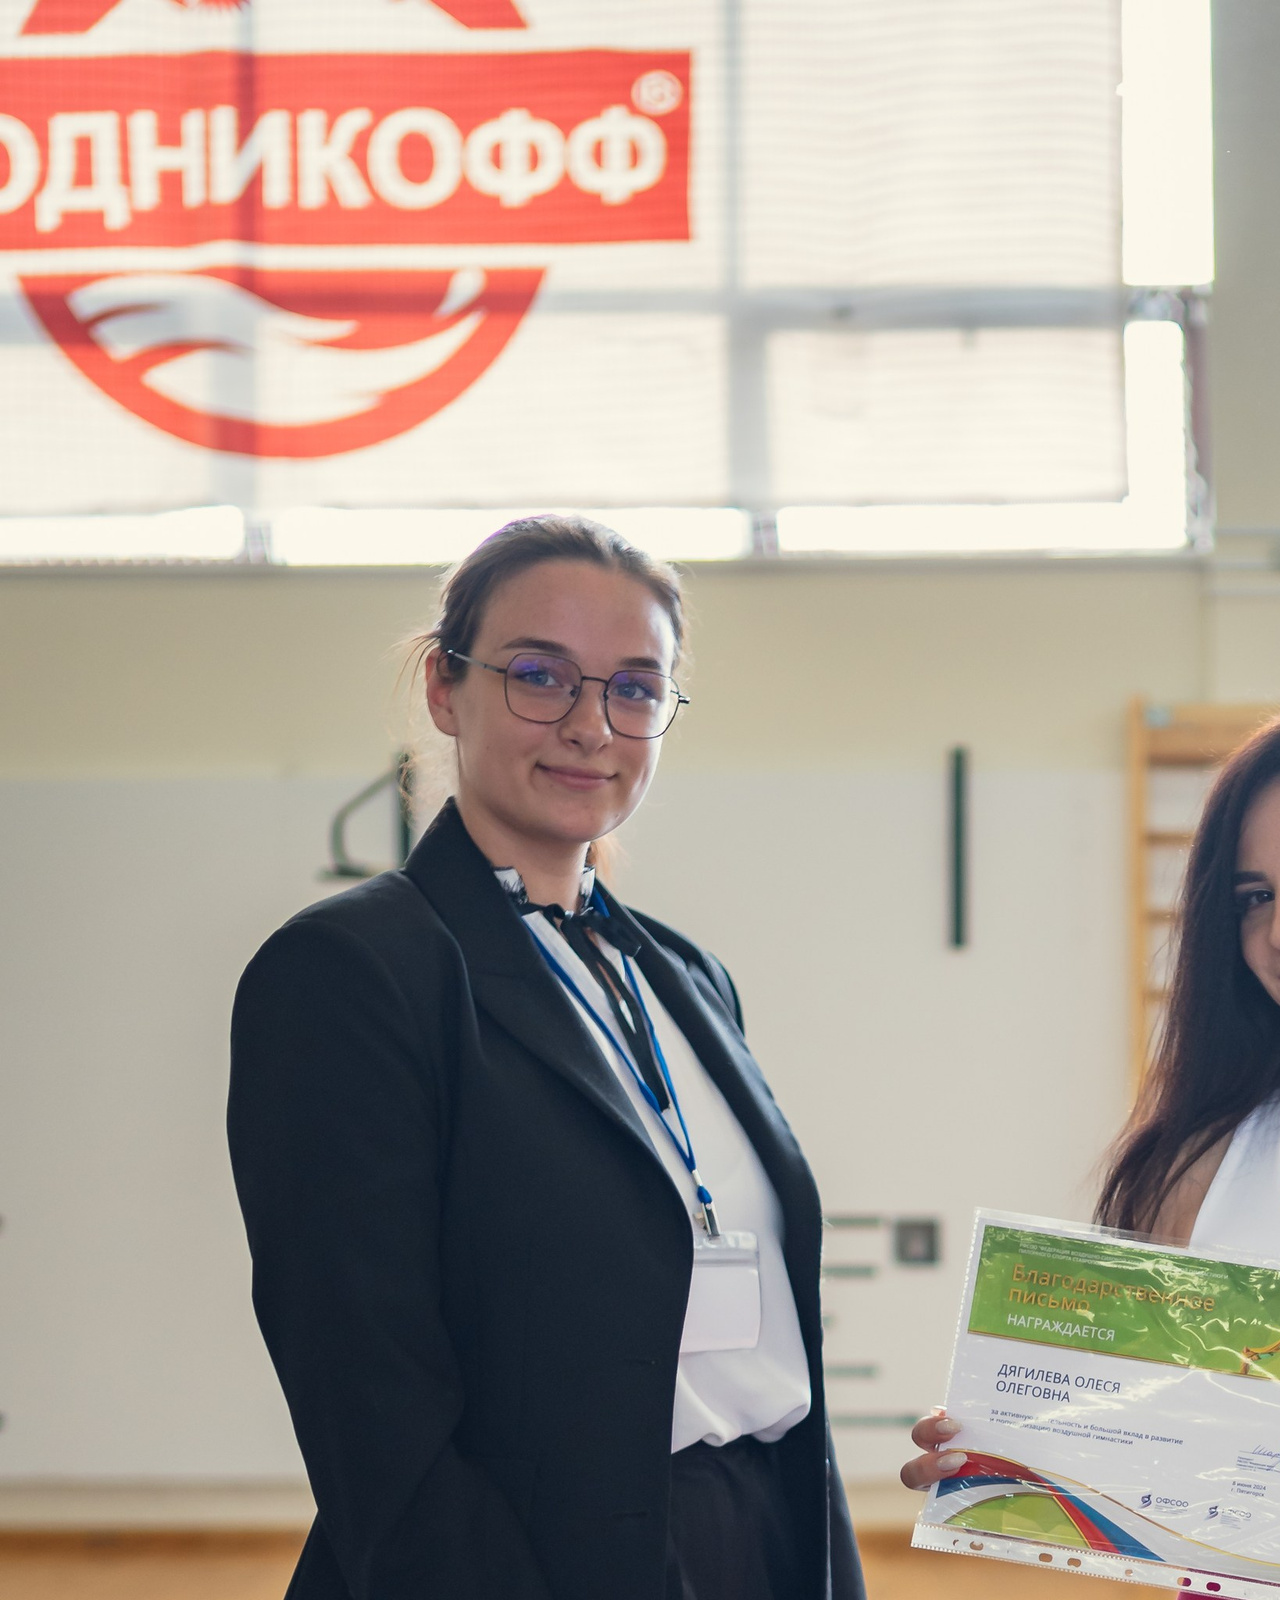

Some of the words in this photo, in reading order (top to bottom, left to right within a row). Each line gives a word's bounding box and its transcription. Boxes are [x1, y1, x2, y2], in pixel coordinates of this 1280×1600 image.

[1009, 1288, 1090, 1313] письмо
[1012, 1264, 1216, 1312] Благодарственное
[1007, 1314, 1115, 1341] НАГРАЖДАЕТСЯ
[997, 1363, 1070, 1385] ДЯГИЛЕВА
[1074, 1376, 1121, 1393] ОЛЕСЯ
[996, 1380, 1070, 1402] ОЛЕГОВНА
[999, 1410, 1033, 1421] активную
[1089, 1424, 1121, 1434] большой
[1123, 1430, 1143, 1439] вклад
[1150, 1435, 1183, 1445] развитие
[1052, 1427, 1090, 1438] воздушной
[1092, 1434, 1133, 1445] гимнастики
[1155, 1496, 1189, 1507] ОФСОО
[1236, 1488, 1264, 1497] Пятигорск
